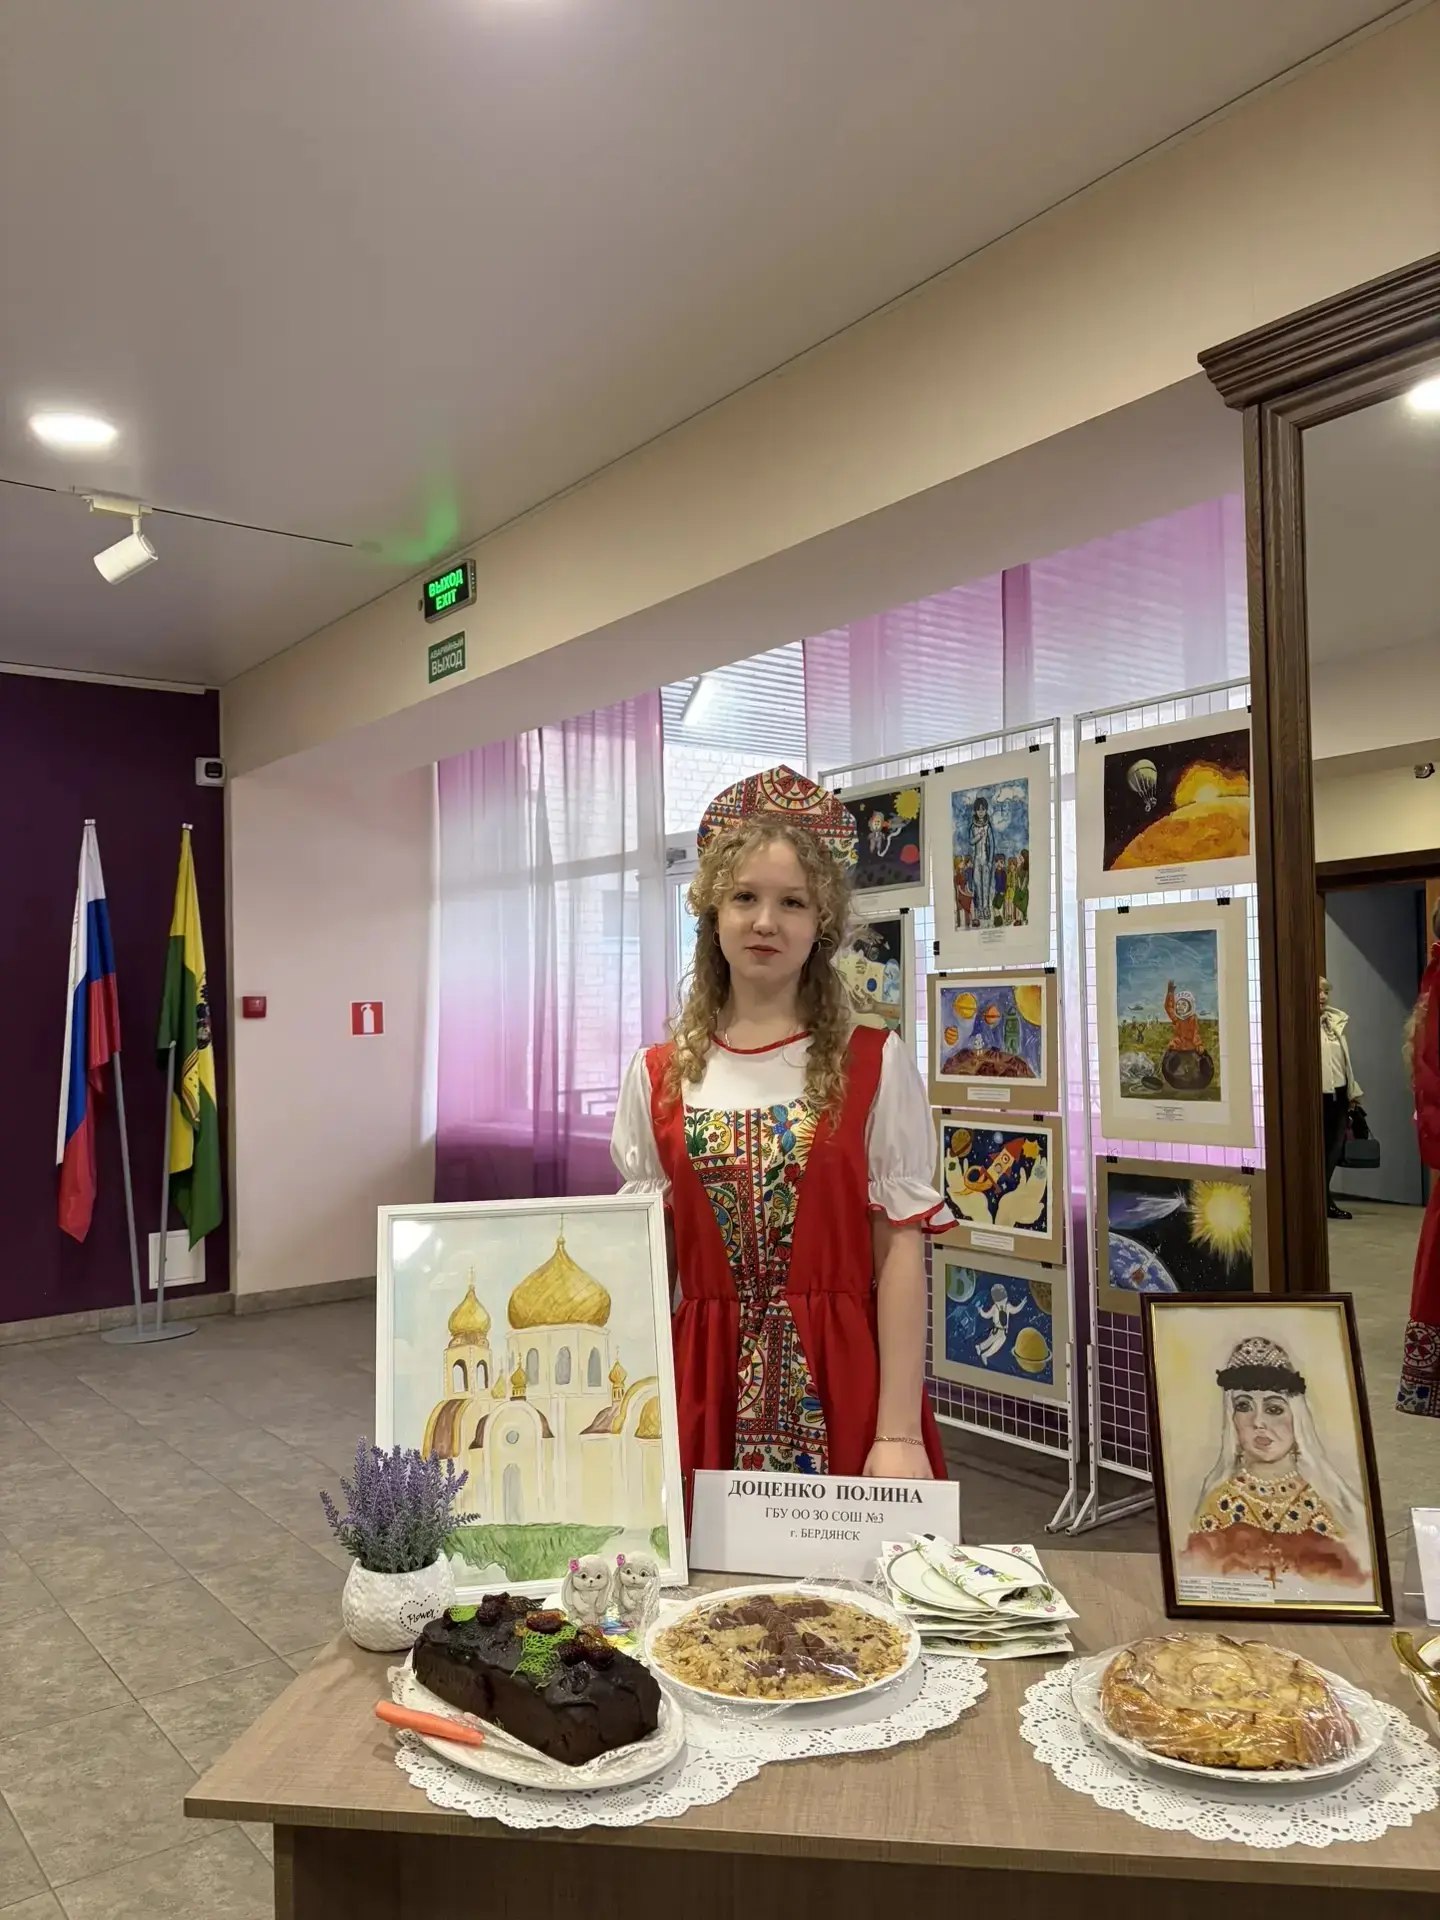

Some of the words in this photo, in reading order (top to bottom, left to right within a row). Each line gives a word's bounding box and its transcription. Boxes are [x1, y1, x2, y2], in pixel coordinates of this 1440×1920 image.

[428, 568, 463, 598] ВЫХОД
[435, 588, 457, 611] EXIT
[431, 649, 463, 676] ВЫХОД
[728, 1479, 826, 1499] ДОЦЕНКО
[836, 1484, 923, 1504] ПОЛИНА
[765, 1506, 789, 1520] ГБУ
[791, 1508, 810, 1521] ОО
[831, 1511, 862, 1523] СОШ
[865, 1512, 884, 1524] №3
[789, 1530, 797, 1538] г.
[800, 1528, 860, 1541] БЕРДЯНСК
